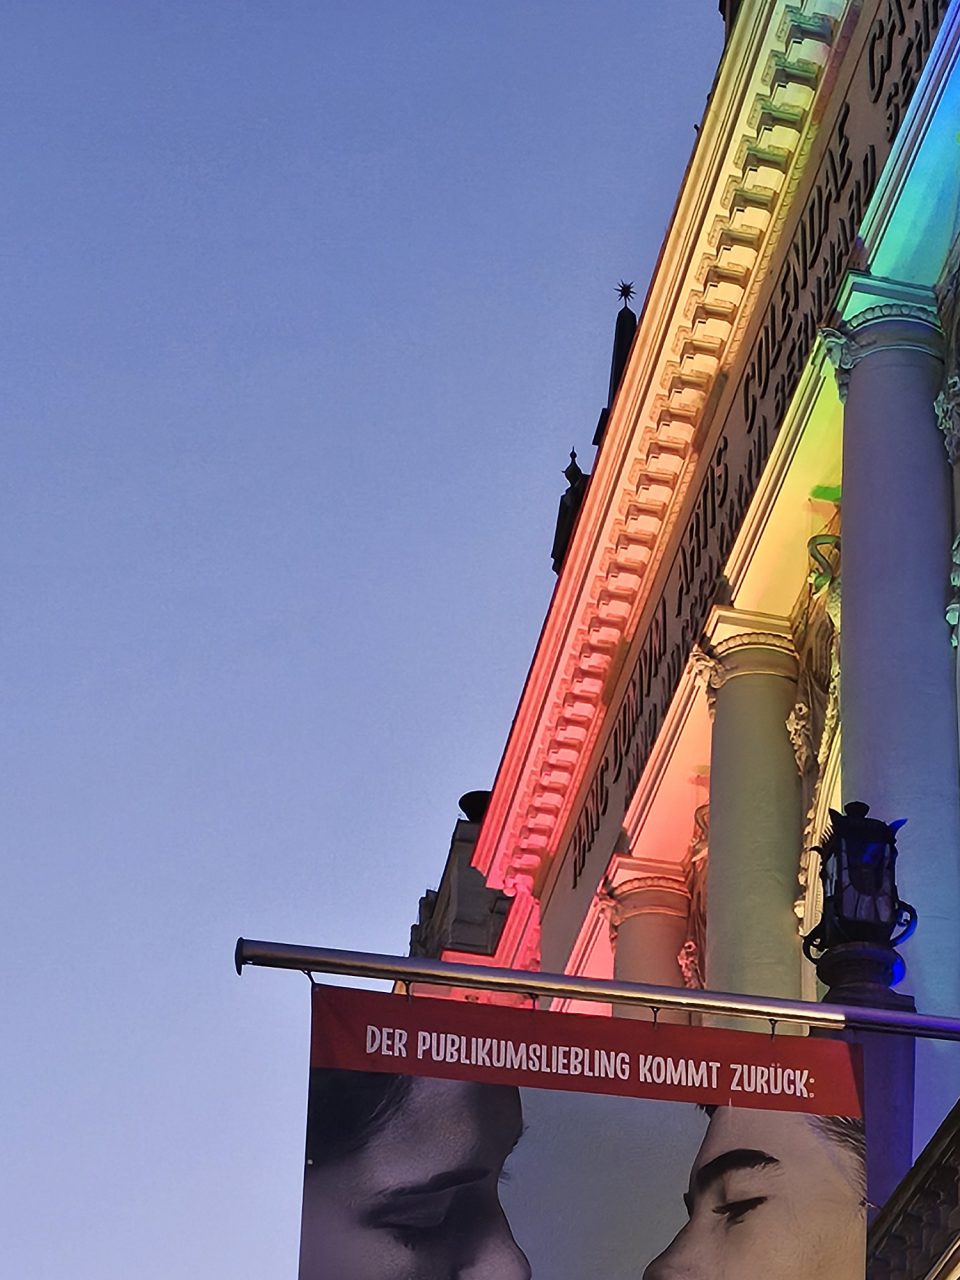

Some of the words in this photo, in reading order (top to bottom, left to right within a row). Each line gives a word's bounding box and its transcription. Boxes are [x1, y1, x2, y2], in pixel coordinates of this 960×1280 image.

[675, 436, 729, 619] ARTIS
[743, 101, 852, 434] COLENDAE
[868, 0, 917, 103] CA
[774, 144, 876, 430] BERNHARD
[366, 1025, 407, 1057] DER
[417, 1031, 629, 1079] PUBLIKUMSLIEBLING
[639, 1054, 720, 1088] KOMMT
[730, 1063, 815, 1098] ZURÜCK:
